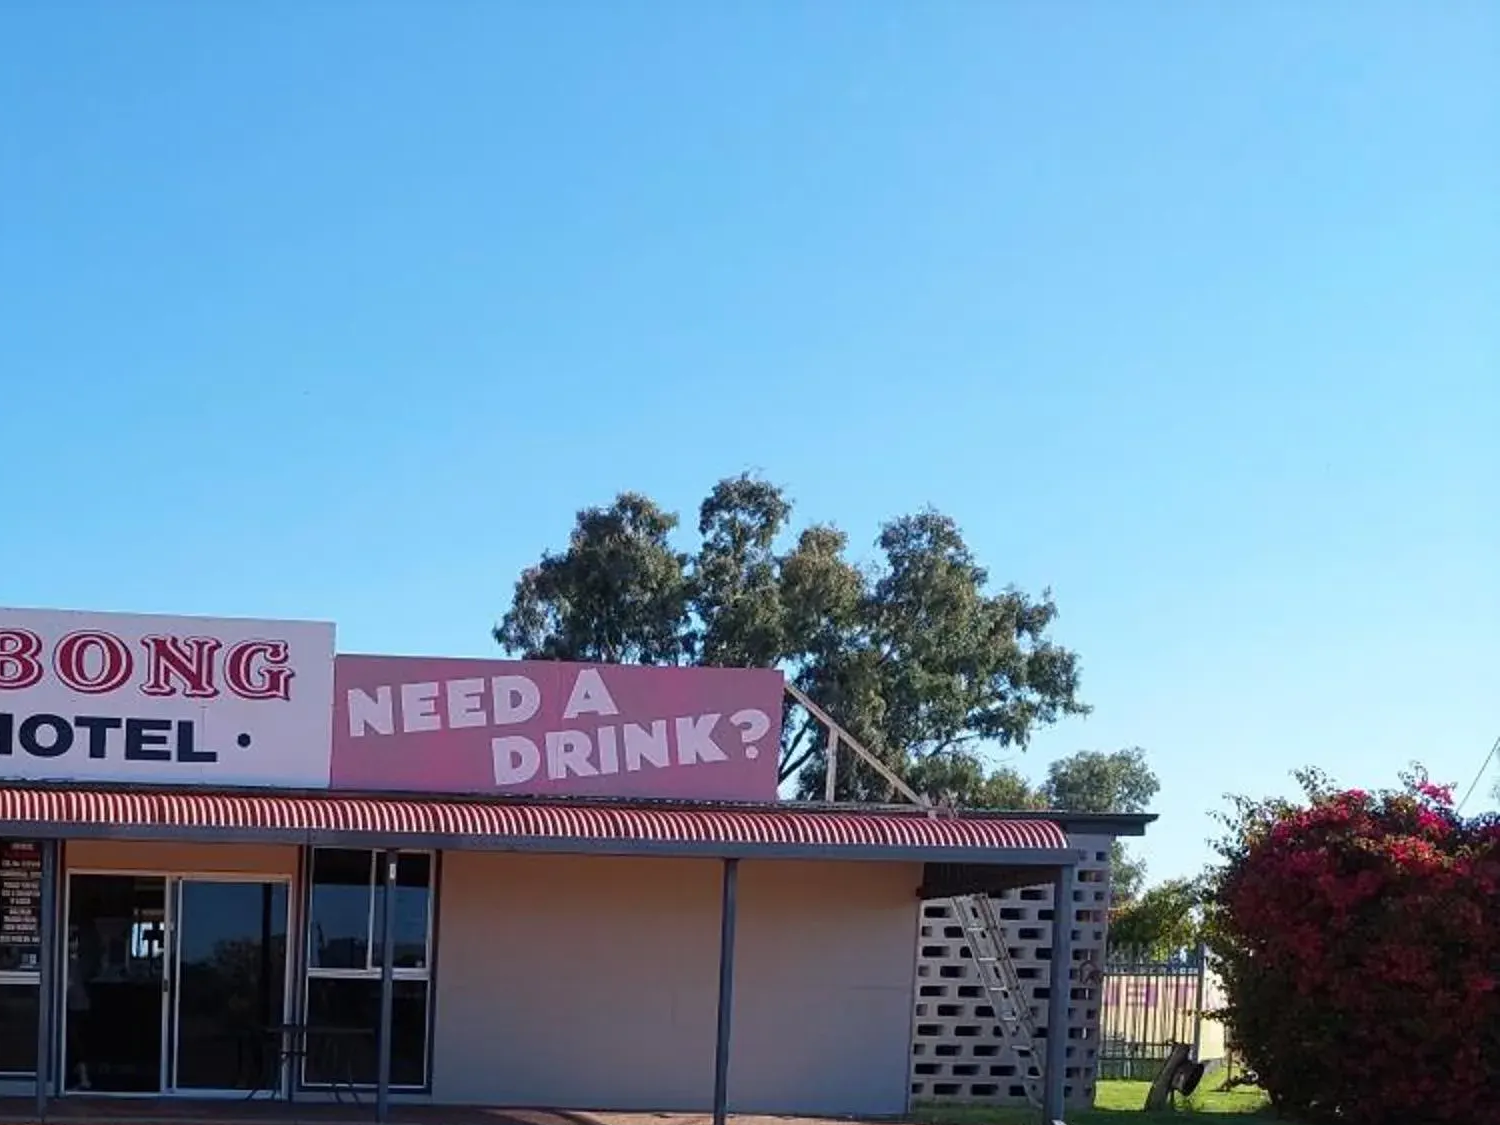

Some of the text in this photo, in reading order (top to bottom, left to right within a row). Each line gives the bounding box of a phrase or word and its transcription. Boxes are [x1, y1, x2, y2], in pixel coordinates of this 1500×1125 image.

[347, 668, 619, 738] NEED A
[491, 708, 771, 786] DRINK?
